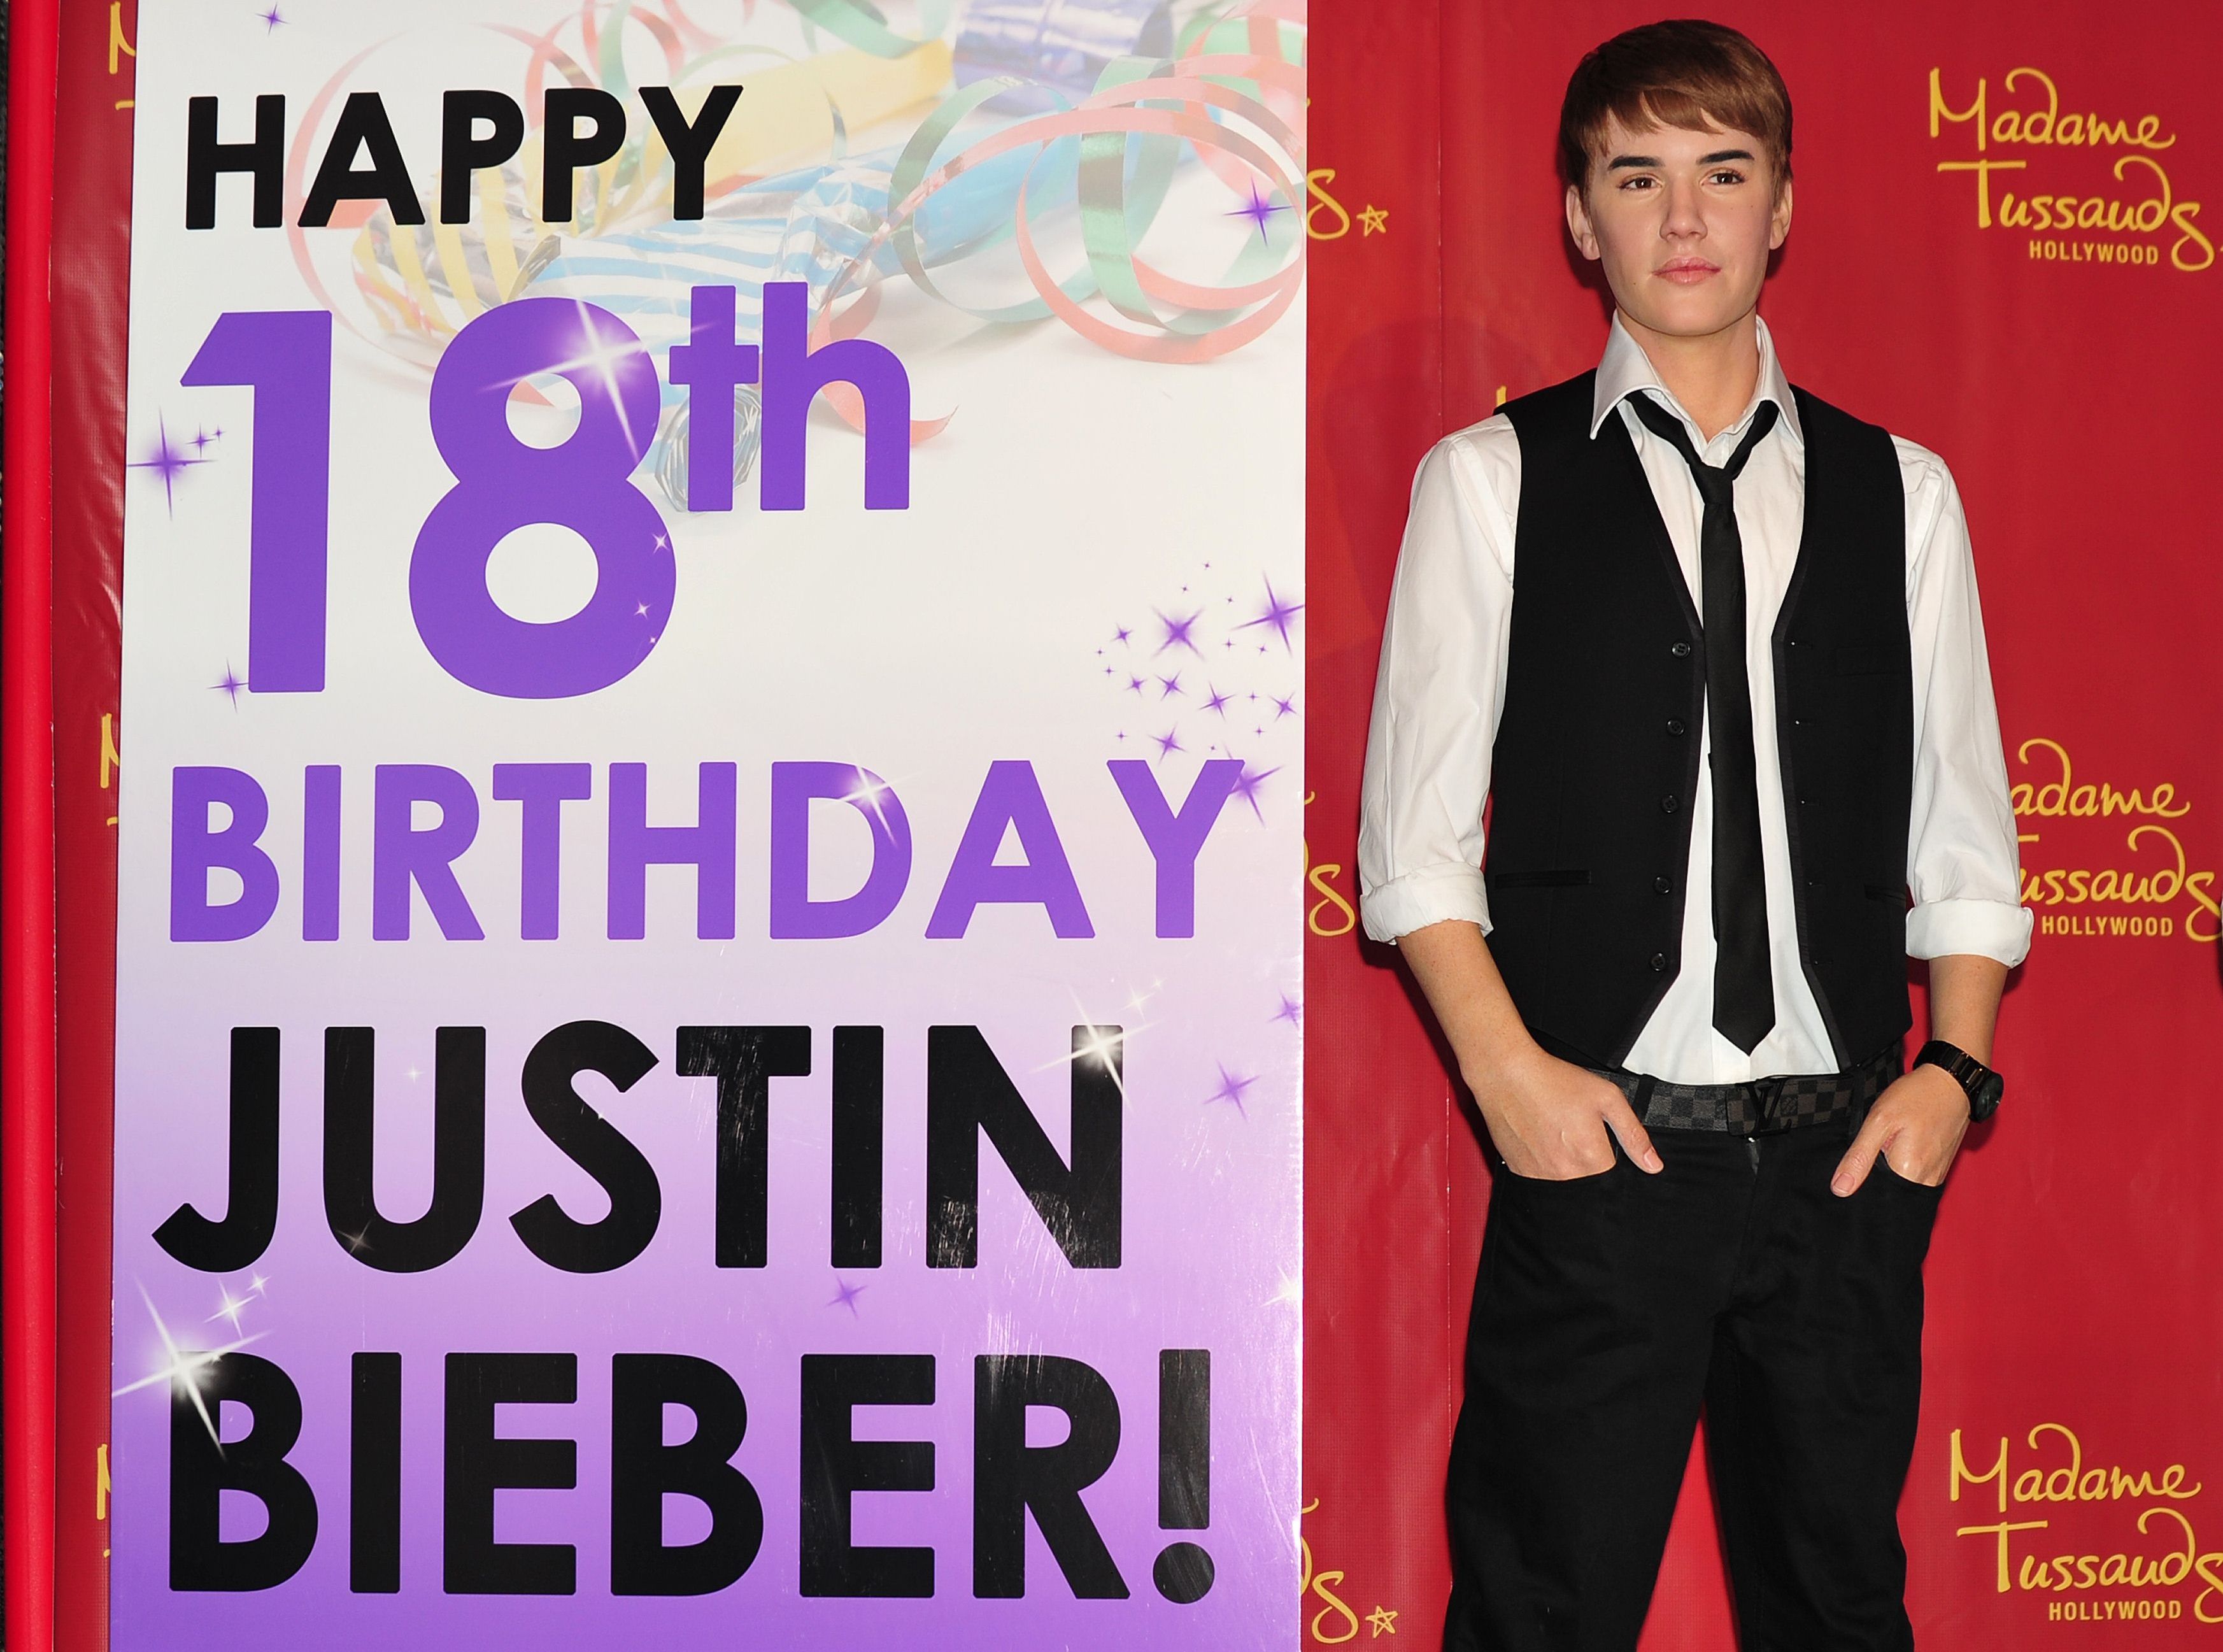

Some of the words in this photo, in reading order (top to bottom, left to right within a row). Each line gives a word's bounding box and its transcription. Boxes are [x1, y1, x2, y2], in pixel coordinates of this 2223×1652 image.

[185, 84, 744, 231] HAPPY
[1929, 67, 2177, 152] Madame
[1936, 155, 2215, 272] Tussauds
[2029, 240, 2159, 265] HOLLYWOOD
[180, 281, 912, 700] 18th
[2010, 737, 2191, 818] adame
[169, 758, 1246, 943] BIRTHDAY
[2041, 915, 2174, 937] HOLLYWOOD
[152, 1020, 1123, 1274] JUSTIN
[169, 1349, 1216, 1605] BIEBER!
[1950, 1422, 2203, 1513] Madame
[1956, 1507, 2223, 1623] Tussauds
[2049, 1599, 2182, 1621] HOLLYWOOD
